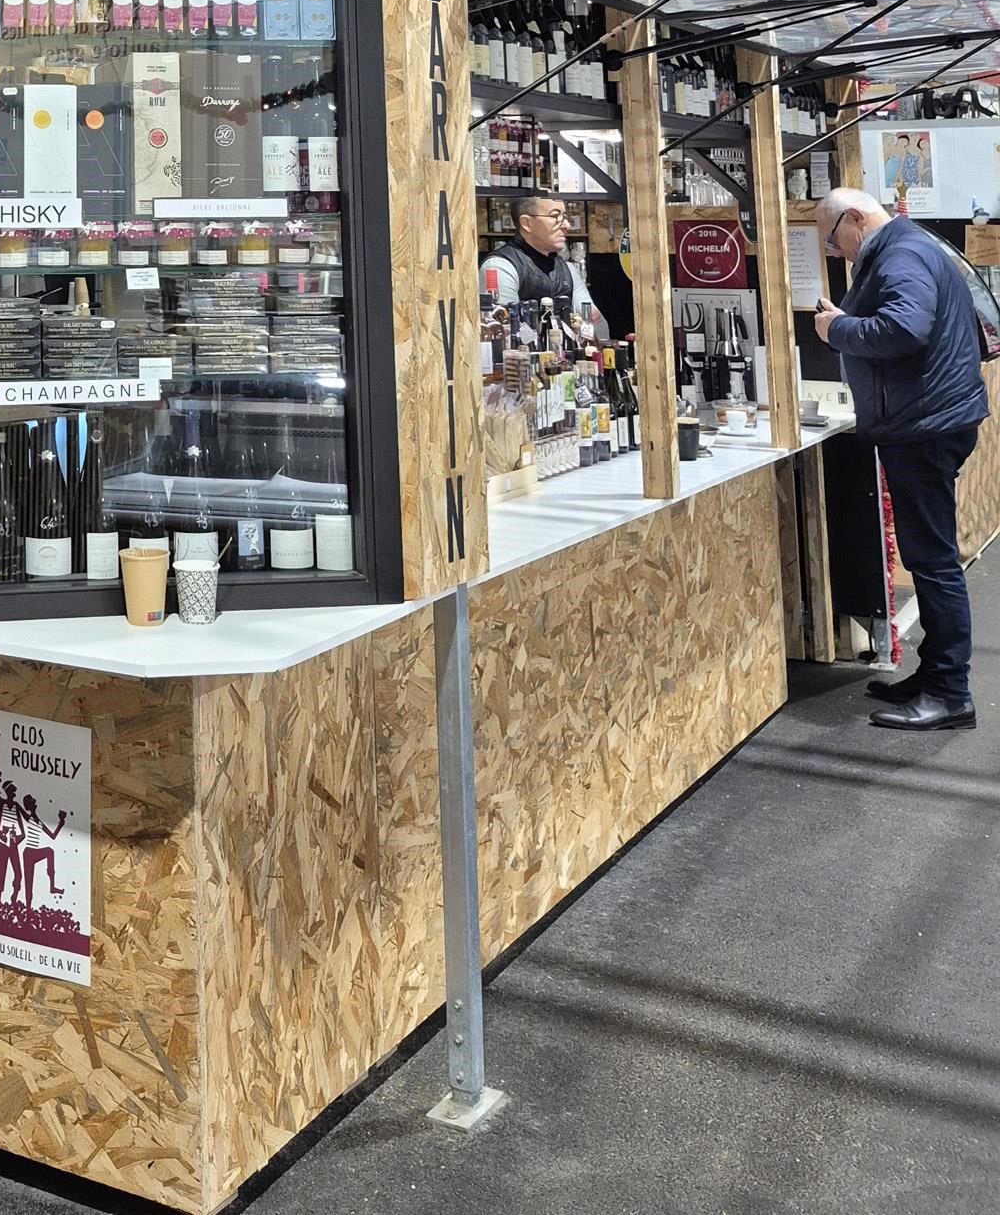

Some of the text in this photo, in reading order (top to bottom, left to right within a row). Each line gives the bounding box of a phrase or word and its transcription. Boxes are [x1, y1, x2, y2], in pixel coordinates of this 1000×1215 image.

[149, 97, 166, 107] RUM
[317, 165, 332, 175] ALE
[687, 245, 730, 253] MICHELIN
[5, 383, 147, 403] CHAMPAGNE
[438, 298, 465, 564] VIN
[12, 723, 45, 747] CLOS
[11, 748, 81, 780] ROUSSELY
[5, 941, 33, 963] SOLEIL
[38, 952, 48, 967] DE
[51, 955, 63, 970] LA
[66, 959, 82, 975] VIE
